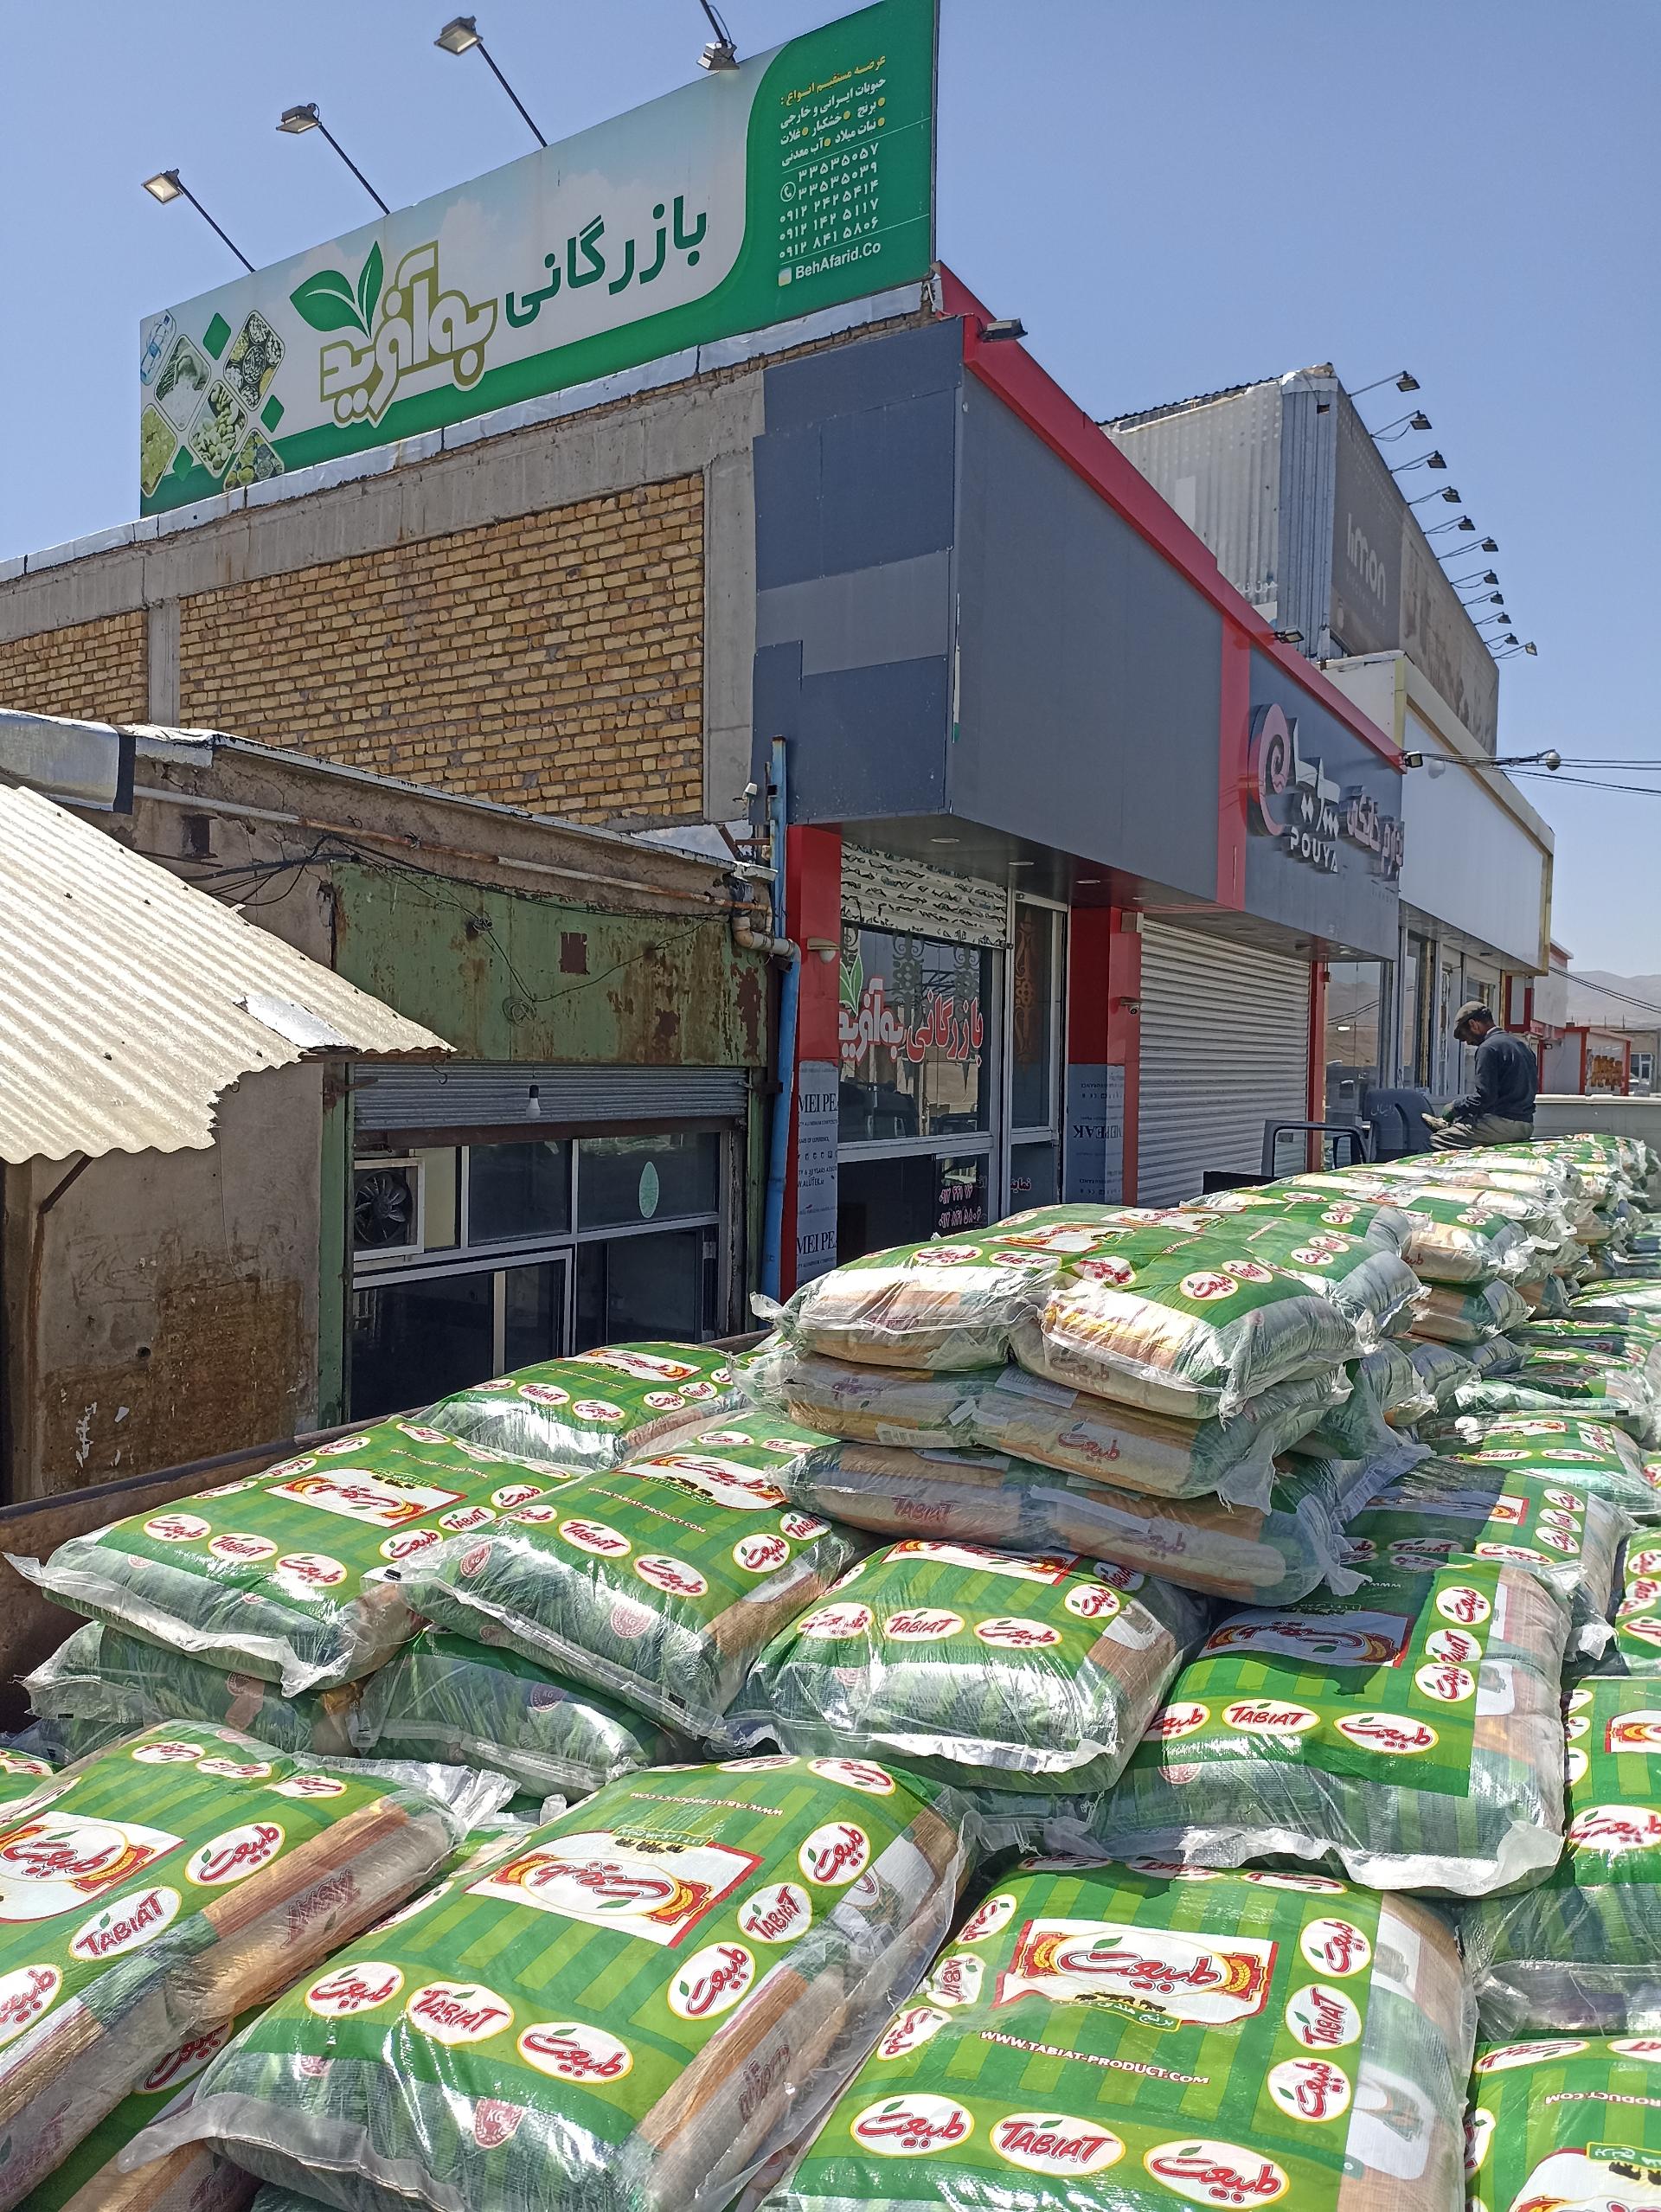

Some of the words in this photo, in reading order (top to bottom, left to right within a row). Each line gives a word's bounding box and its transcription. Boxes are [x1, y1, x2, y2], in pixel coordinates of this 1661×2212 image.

[820, 87, 853, 113] ایرانی
[857, 101, 876, 118] برنج
[780, 106, 811, 129] خارجی
[857, 119, 876, 135] نبات
[780, 130, 800, 144] غلات
[811, 137, 824, 155] آب
[782, 149, 809, 167] معدنی
[505, 195, 707, 329] بازرگانی
[795, 242, 881, 279] BehAfarid.Co
[1291, 826, 1338, 874] POUYA
[907, 990, 984, 1068] بازرگانی
[1193, 1272, 1234, 1298] طبیعت
[521, 1385, 566, 1402] TABIAT
[1058, 1429, 1120, 1462] طبیعت
[673, 1459, 768, 1491] طبیعت
[501, 1486, 542, 1509] طبیعت
[147, 1520, 204, 1542] طبیعت
[446, 1508, 493, 1532] TABIAT
[212, 1536, 274, 1557] TABIAT
[392, 1529, 440, 1559] طبیعت
[563, 1522, 629, 1553] TABIAT
[744, 1536, 788, 1571] طبیعت
[279, 1559, 343, 1585] طبیعت
[637, 1558, 705, 1594] طبیعت
[1080, 1585, 1117, 1617] طبیعت
[1453, 1588, 1485, 1624] طبیعت
[888, 1616, 957, 1635] TABIAT
[978, 1625, 1056, 1646] طبیعت
[1433, 1665, 1469, 1700] طبیعت
[1229, 1706, 1311, 1727] TABIAT
[1341, 1722, 1433, 1751] طبیعت
[2, 1843, 121, 1880] طبیعت
[198, 1825, 279, 1883] طبیعت
[815, 1824, 867, 1883] طبیعت
[534, 1860, 676, 1900] طبیعت
[75, 1889, 168, 1958] TABIAT
[747, 1886, 802, 1940] TABIAT
[1324, 1921, 1366, 1973] طبیعت
[686, 1946, 748, 2016] طبیعت
[1056, 1950, 1221, 1993] طبیعت
[311, 1976, 399, 2010] طبیعت
[1097, 2000, 1136, 2016] هندی
[417, 1987, 510, 2035] TABIAT
[1138, 2013, 1174, 2026] برنج
[1305, 1987, 1345, 2047] TABIAT
[523, 2034, 624, 2078] طبیعت
[980, 2029, 1210, 2086] WWW.TABIAT-PRODUCT.COM
[1296, 2061, 1343, 2119] طبیعت
[857, 2106, 965, 2149] طبیعت
[1001, 2122, 1117, 2163] TABIAT
[1150, 2151, 1279, 2202] طبیعت
